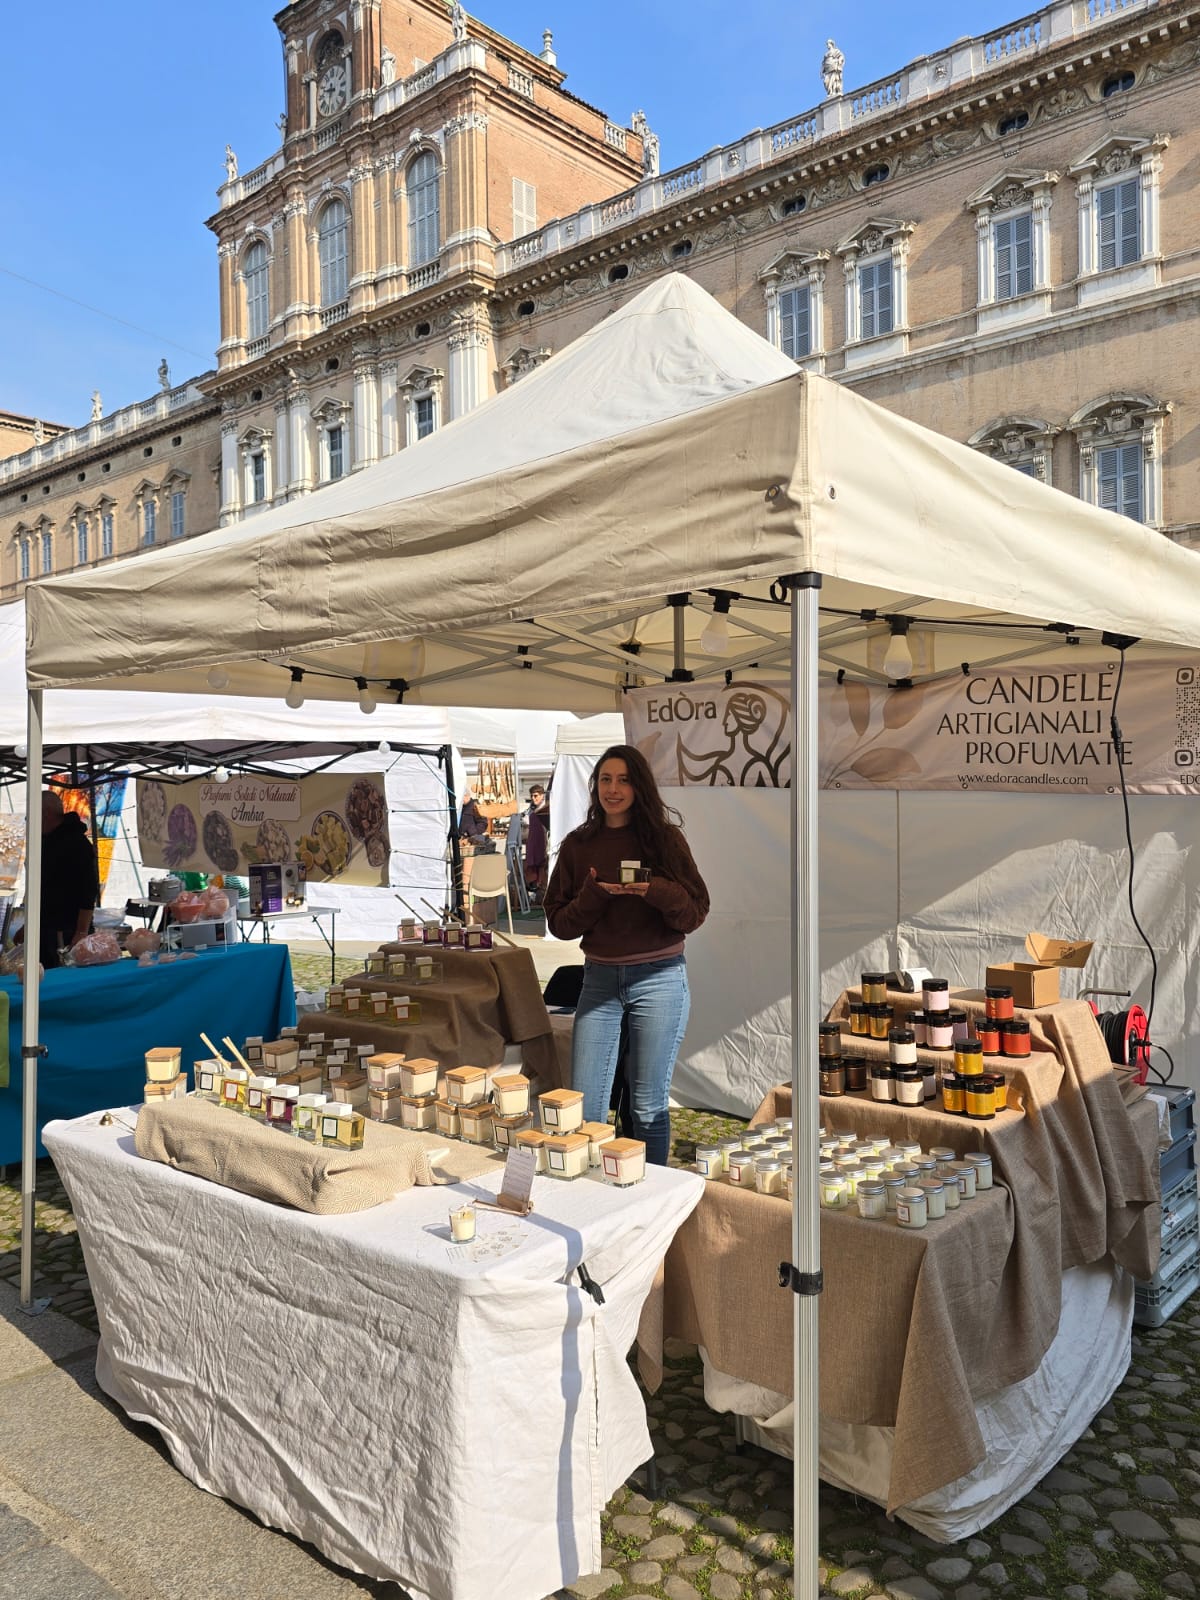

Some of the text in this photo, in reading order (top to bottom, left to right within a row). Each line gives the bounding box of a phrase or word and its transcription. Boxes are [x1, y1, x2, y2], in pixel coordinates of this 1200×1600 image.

[966, 671, 1114, 705] CANDELE
[646, 691, 717, 723] EdÒra
[936, 709, 1102, 736] ARTIGIANALI
[965, 740, 1134, 766] PROFUMATE
[957, 772, 1089, 786] www.edoracandles.com
[259, 784, 299, 803] Naturali
[231, 801, 265, 822] Ambra
